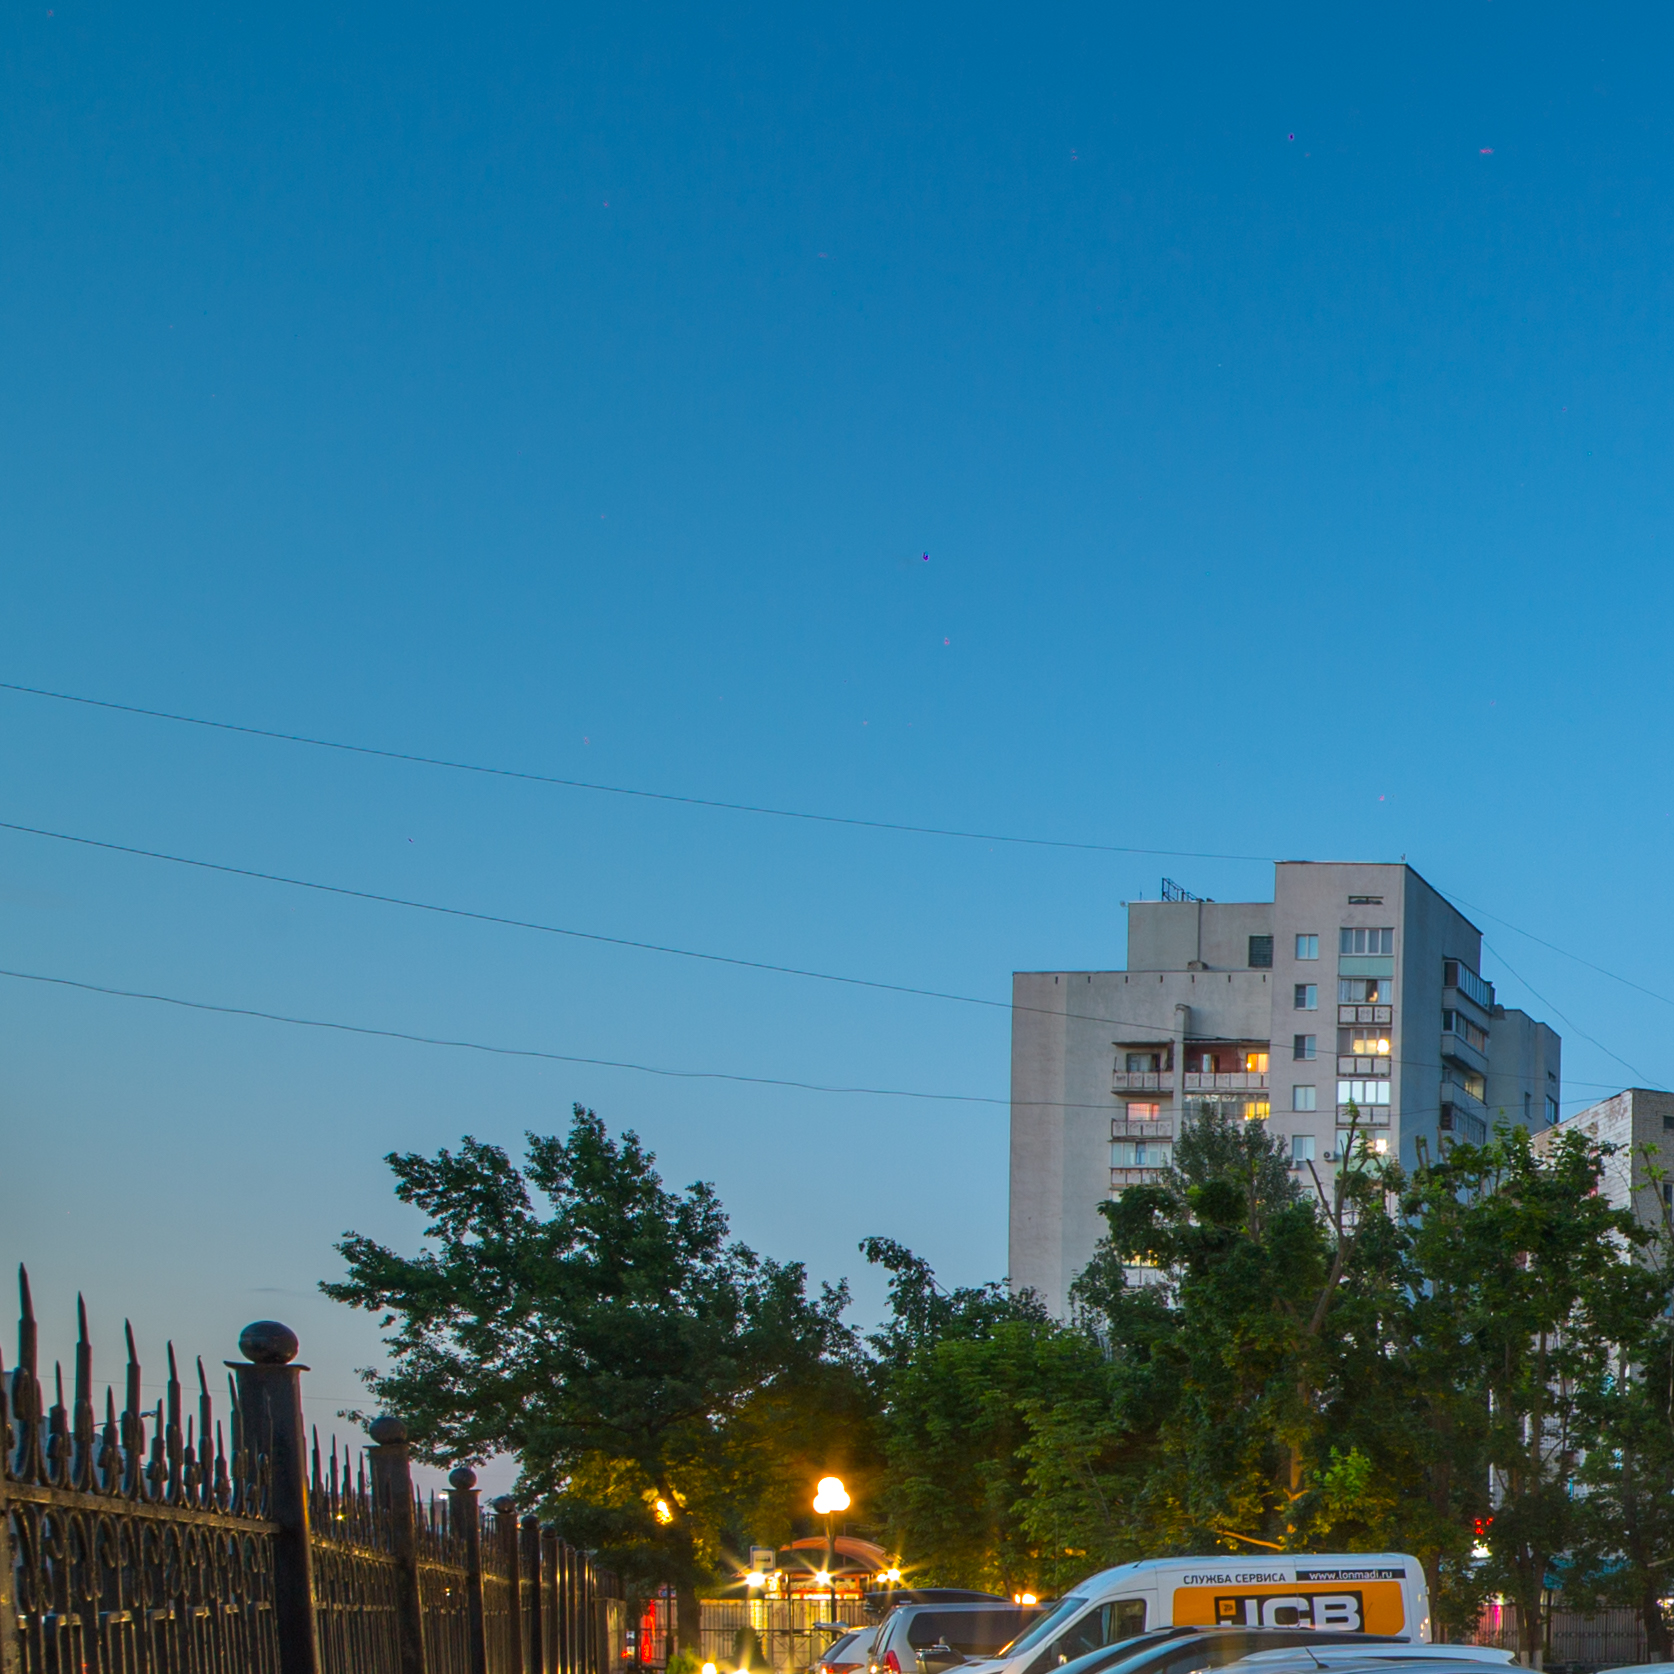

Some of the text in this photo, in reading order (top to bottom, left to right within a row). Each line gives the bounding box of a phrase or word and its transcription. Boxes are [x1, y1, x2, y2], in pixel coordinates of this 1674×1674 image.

[1183, 1572, 1287, 1585] СЛУЖБА СЕРВИСА
[1308, 1569, 1393, 1580] www.lonmadi.ru
[1219, 1595, 1361, 1631] JCB
